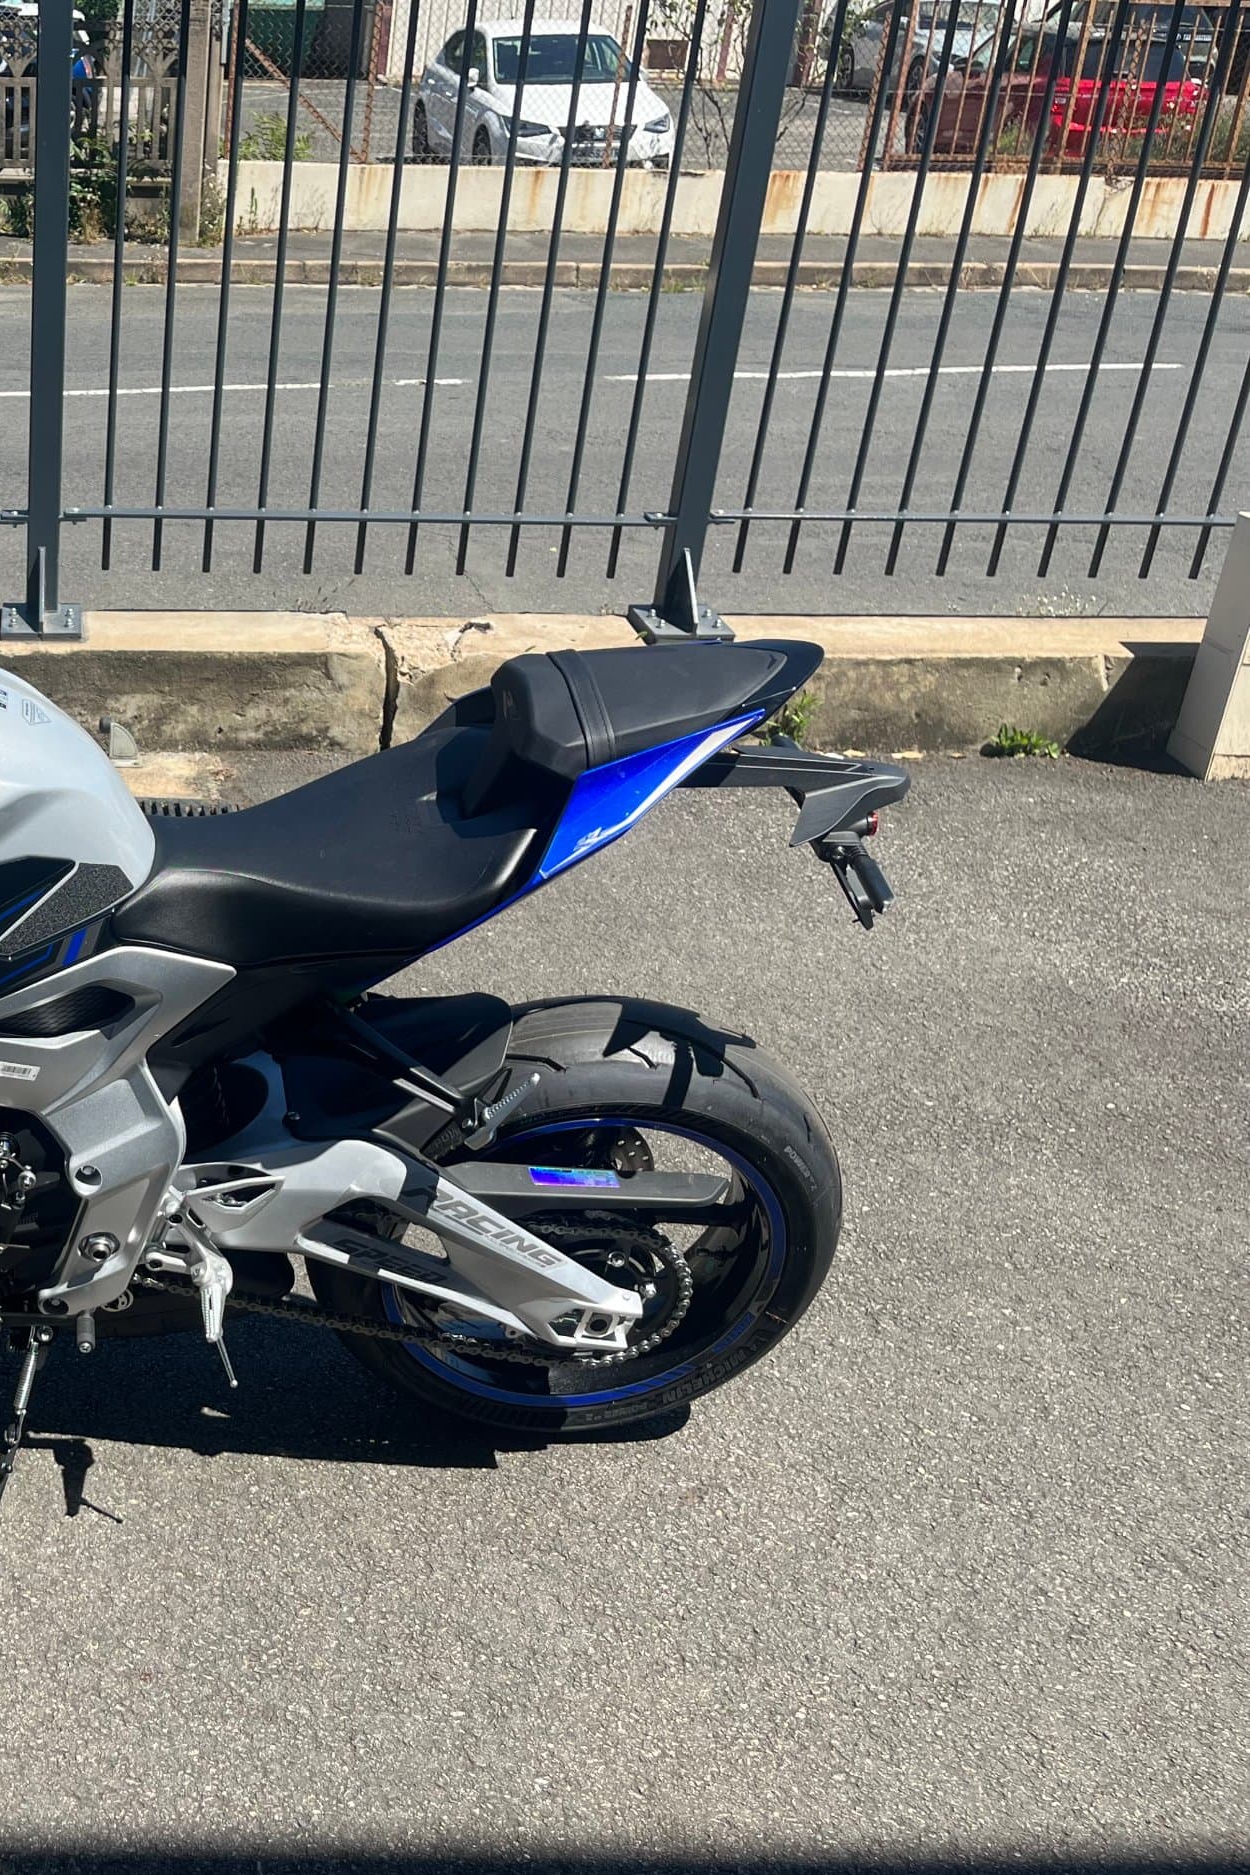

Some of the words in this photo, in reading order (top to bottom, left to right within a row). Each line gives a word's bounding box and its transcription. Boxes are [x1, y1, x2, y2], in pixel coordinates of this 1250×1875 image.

[783, 1145, 811, 1179] POWER
[333, 1238, 449, 1283] SPEED
[661, 1350, 747, 1404] MICHELIN
